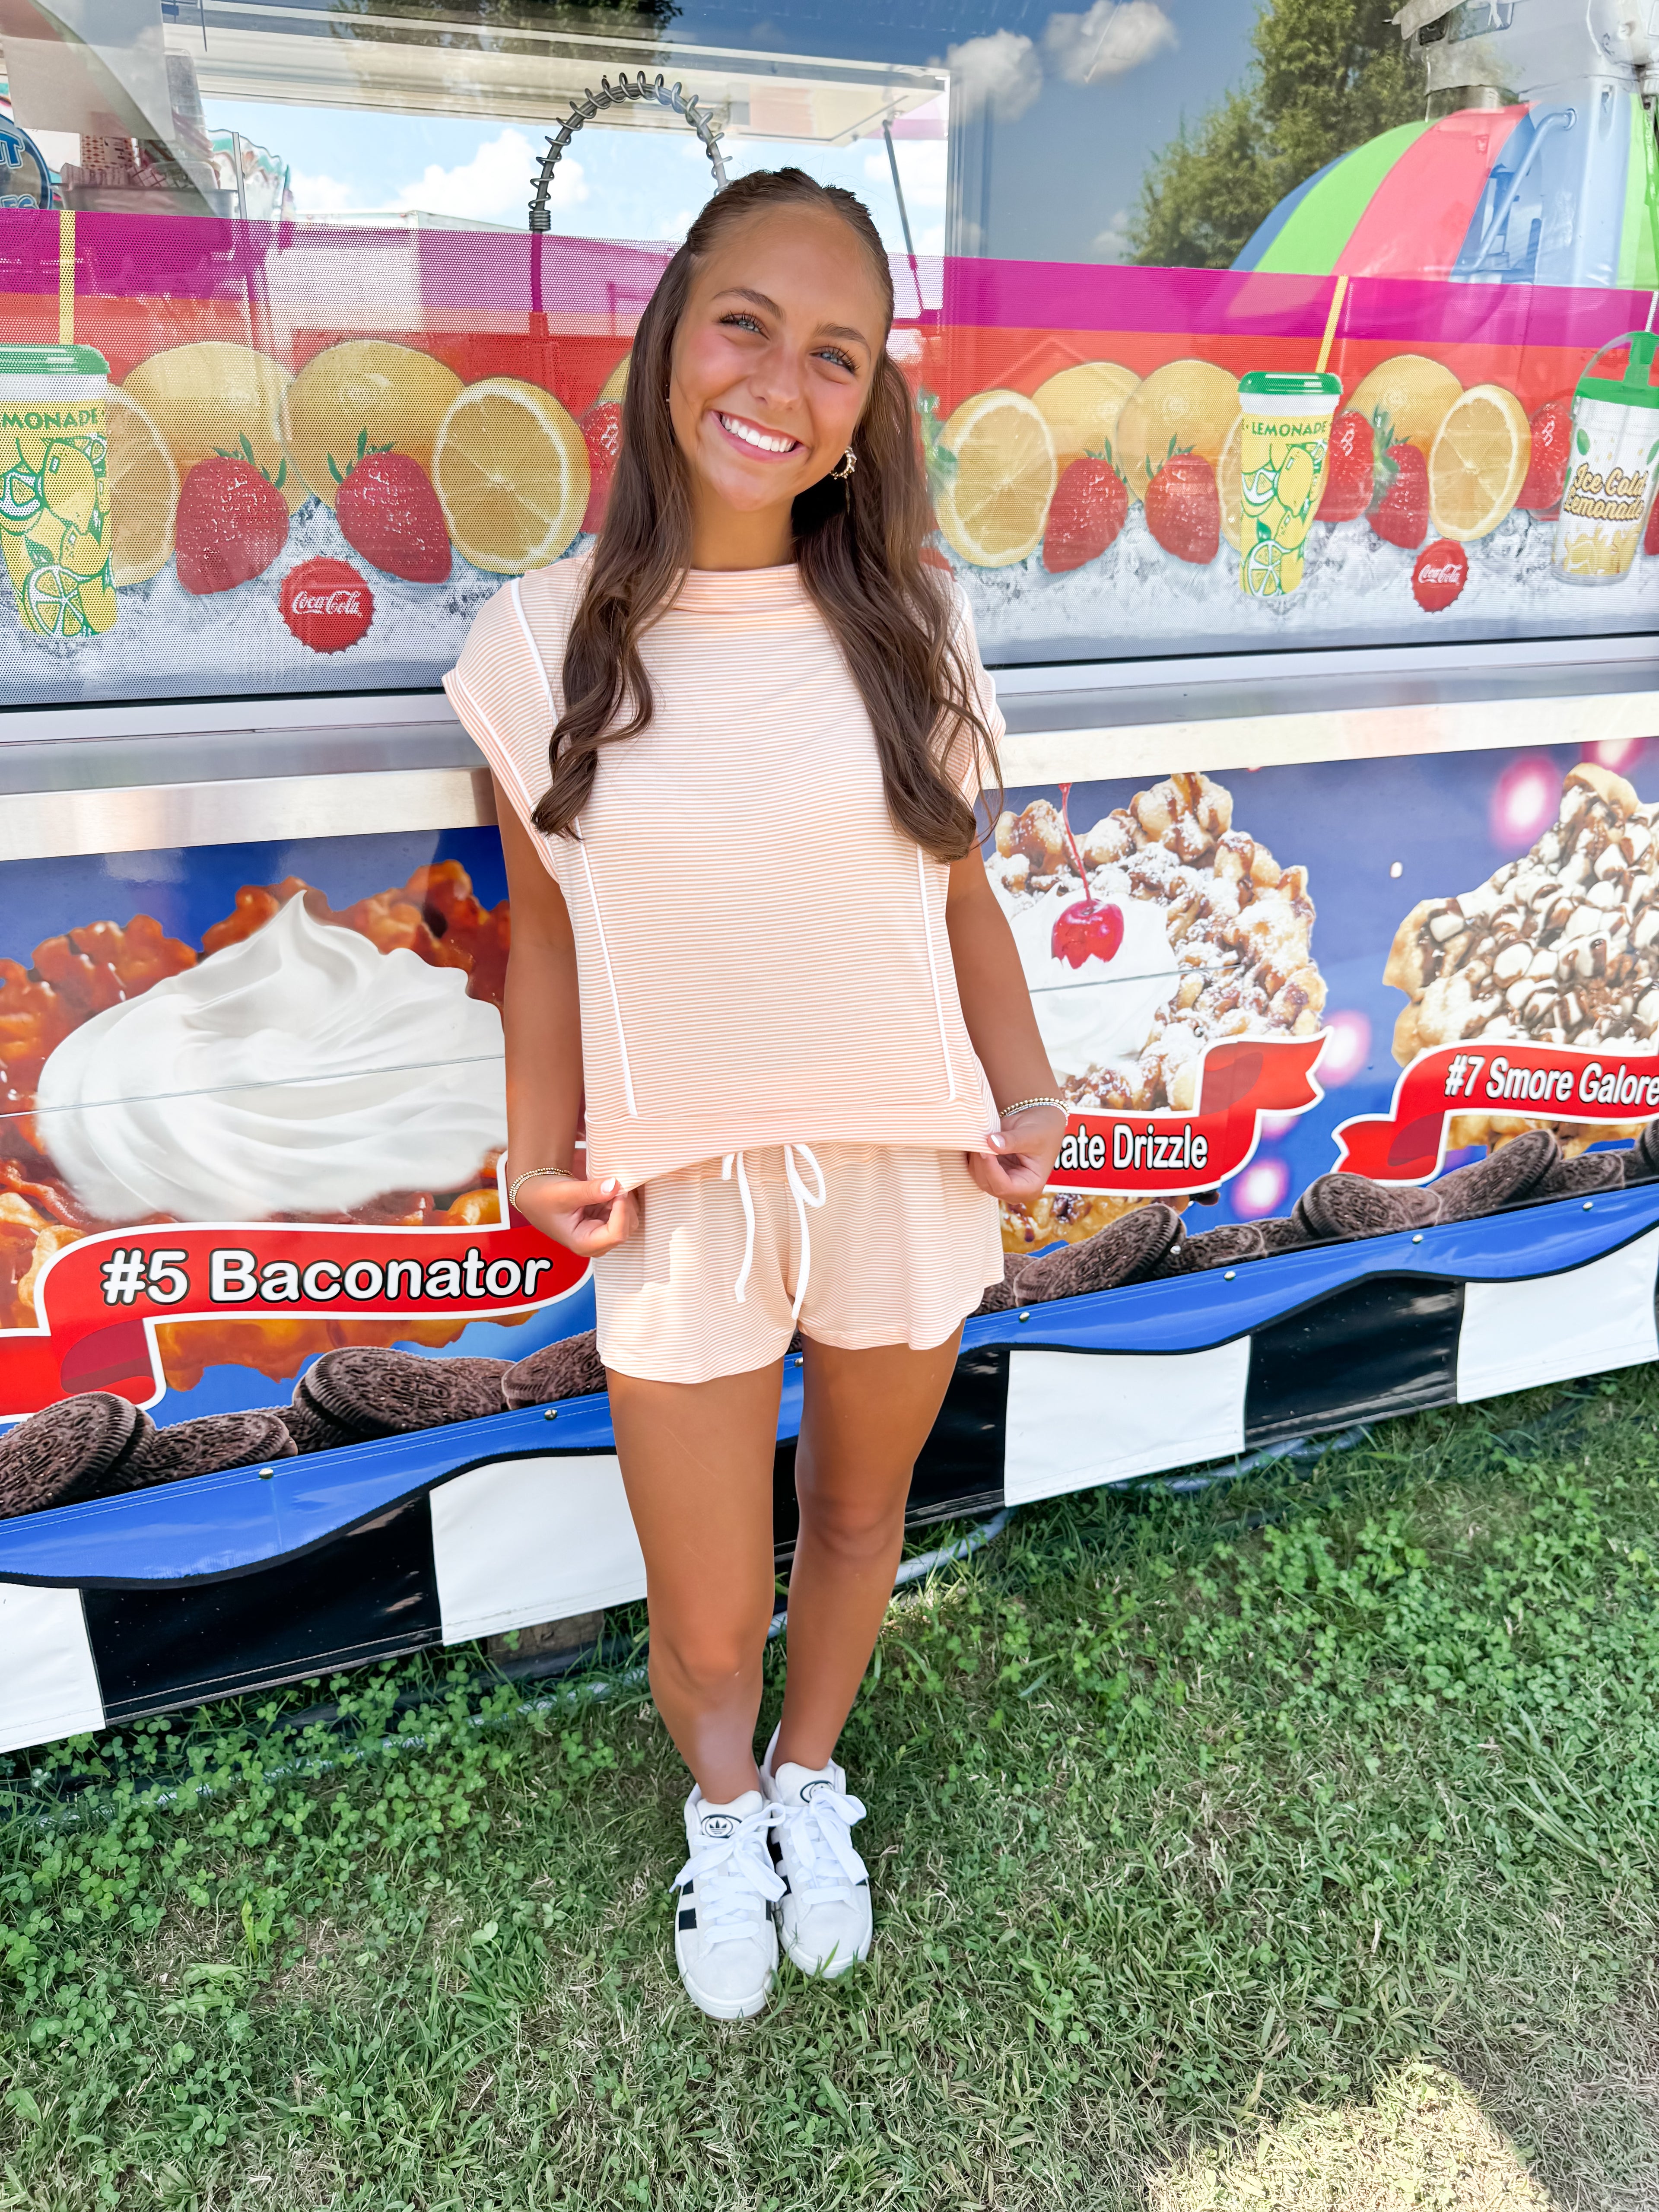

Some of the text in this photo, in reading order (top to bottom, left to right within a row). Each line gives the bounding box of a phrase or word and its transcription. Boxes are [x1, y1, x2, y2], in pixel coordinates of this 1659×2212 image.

[1252, 421, 1328, 437] LEMONADE
[1573, 461, 1648, 497] Ice Cold
[1444, 1054, 1659, 1106] #7 Smore Galore
[1112, 1123, 1208, 1170] Drizzle
[100, 1247, 552, 1306] #5 Baconator
